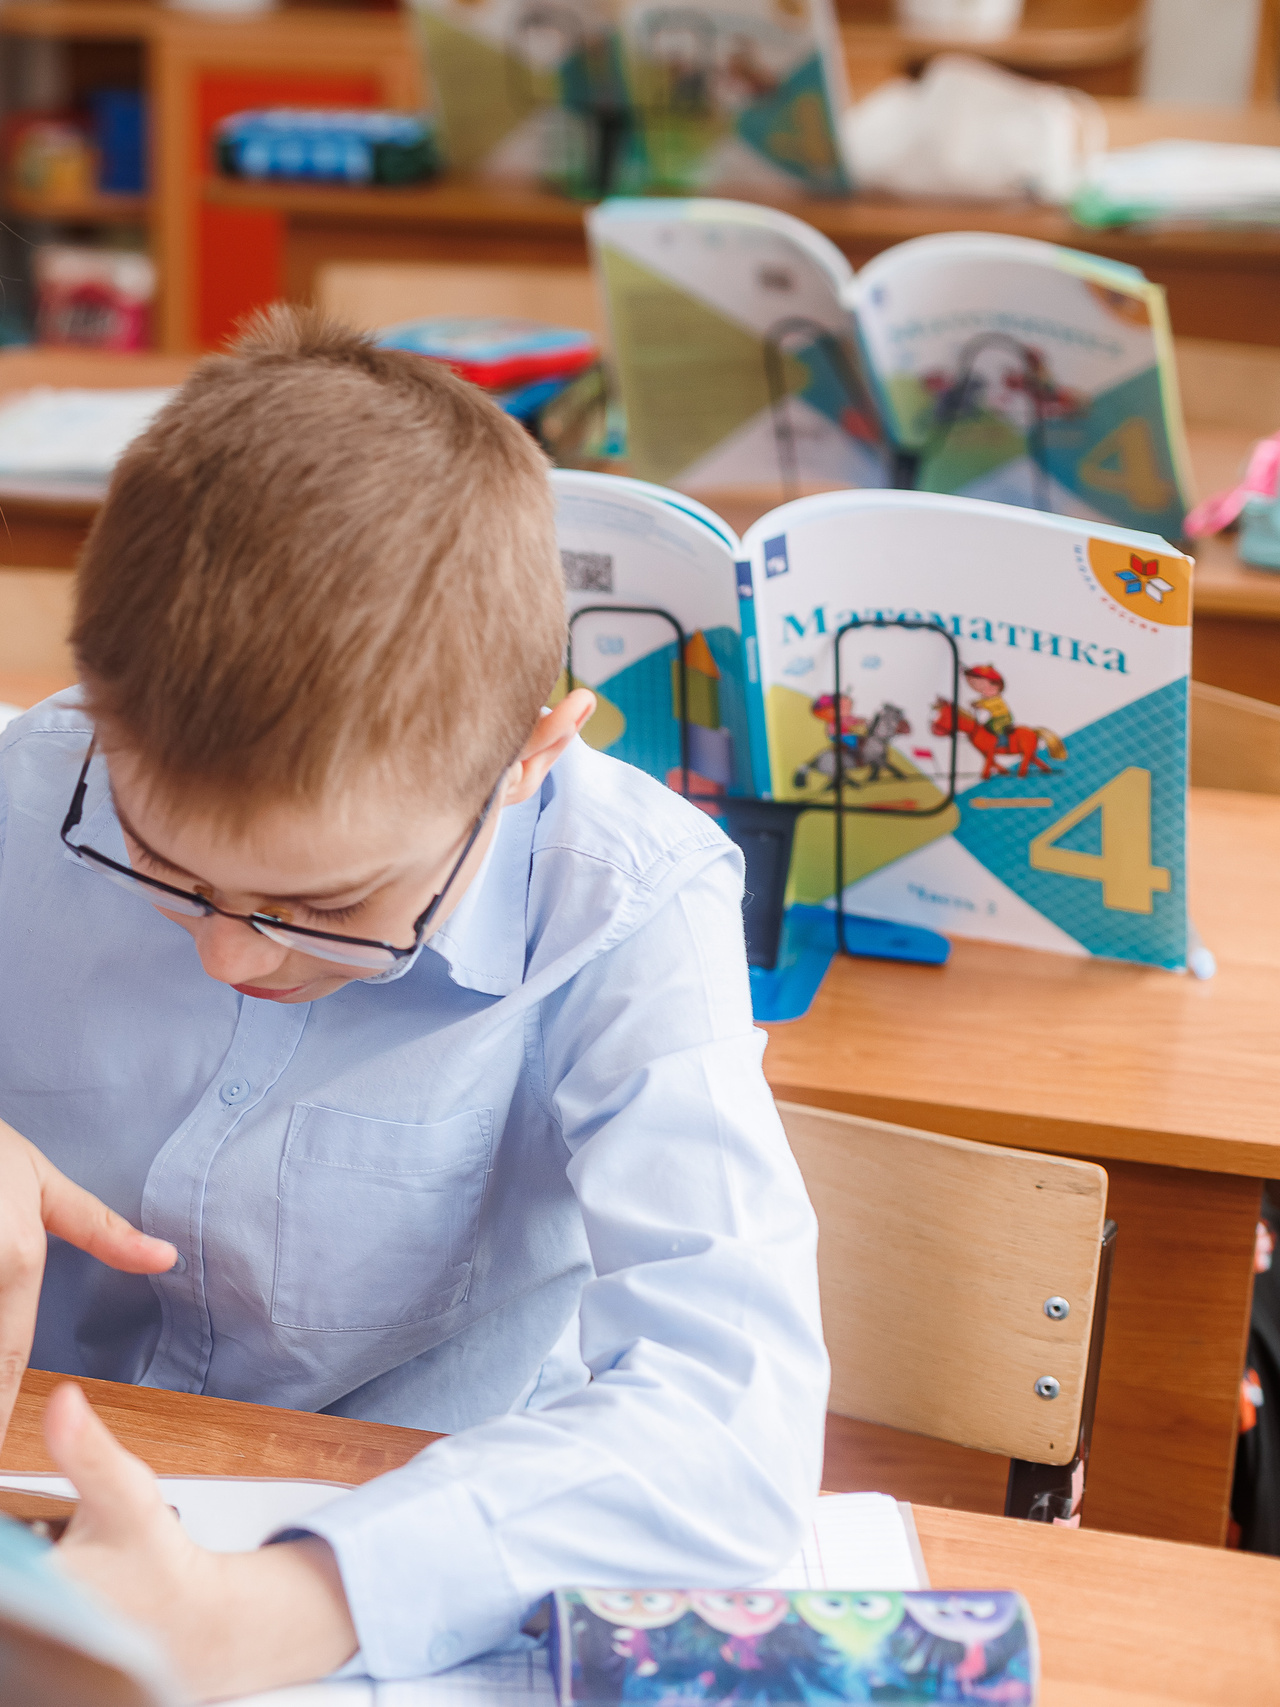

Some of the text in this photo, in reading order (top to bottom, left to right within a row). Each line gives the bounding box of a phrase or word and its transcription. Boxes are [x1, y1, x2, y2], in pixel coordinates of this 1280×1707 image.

[1079, 416, 1177, 513] 4
[780, 604, 1130, 674] Математика
[1029, 766, 1171, 915] 4
